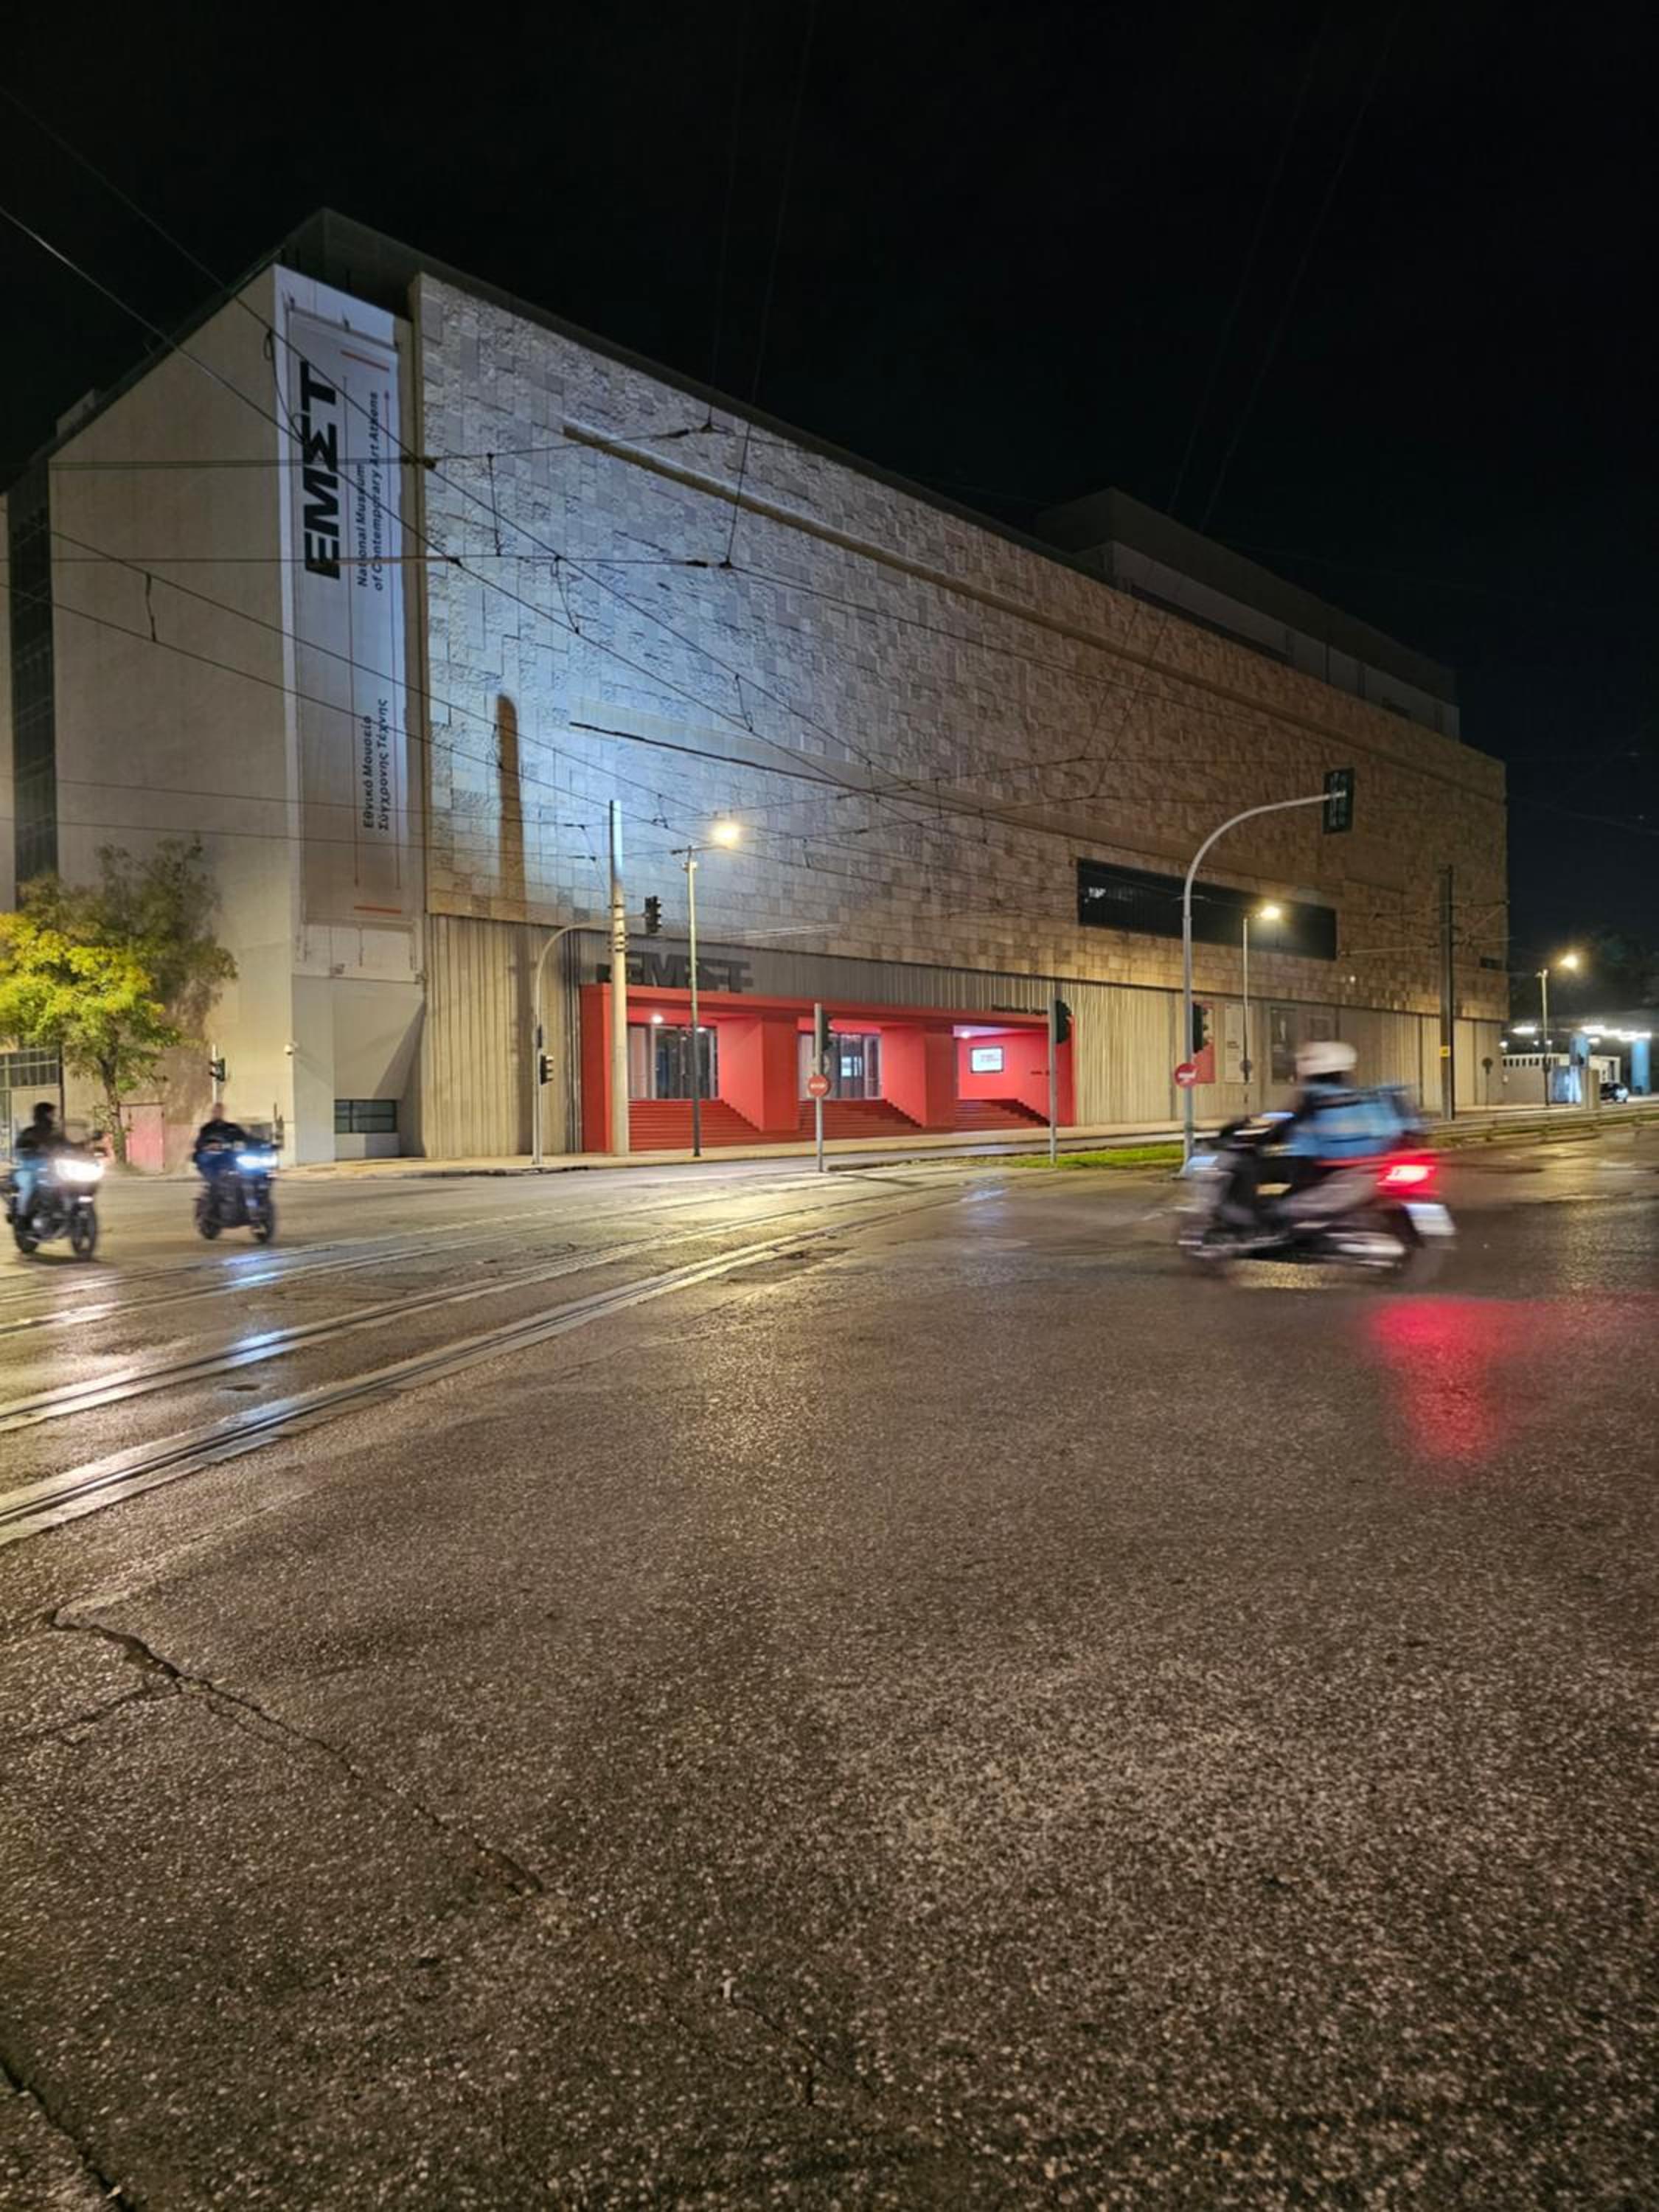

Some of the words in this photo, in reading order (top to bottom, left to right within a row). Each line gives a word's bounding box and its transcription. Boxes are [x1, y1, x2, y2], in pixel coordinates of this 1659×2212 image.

[368, 392, 379, 442] Athens
[369, 444, 379, 468] Art
[354, 463, 367, 525] Museum
[370, 470, 383, 574] Contemporary
[355, 526, 369, 588] National
[372, 576, 384, 591] of
[360, 715, 373, 777] Μουσείο
[376, 698, 389, 749] Τέχνης
[361, 779, 375, 829] Εθνικό
